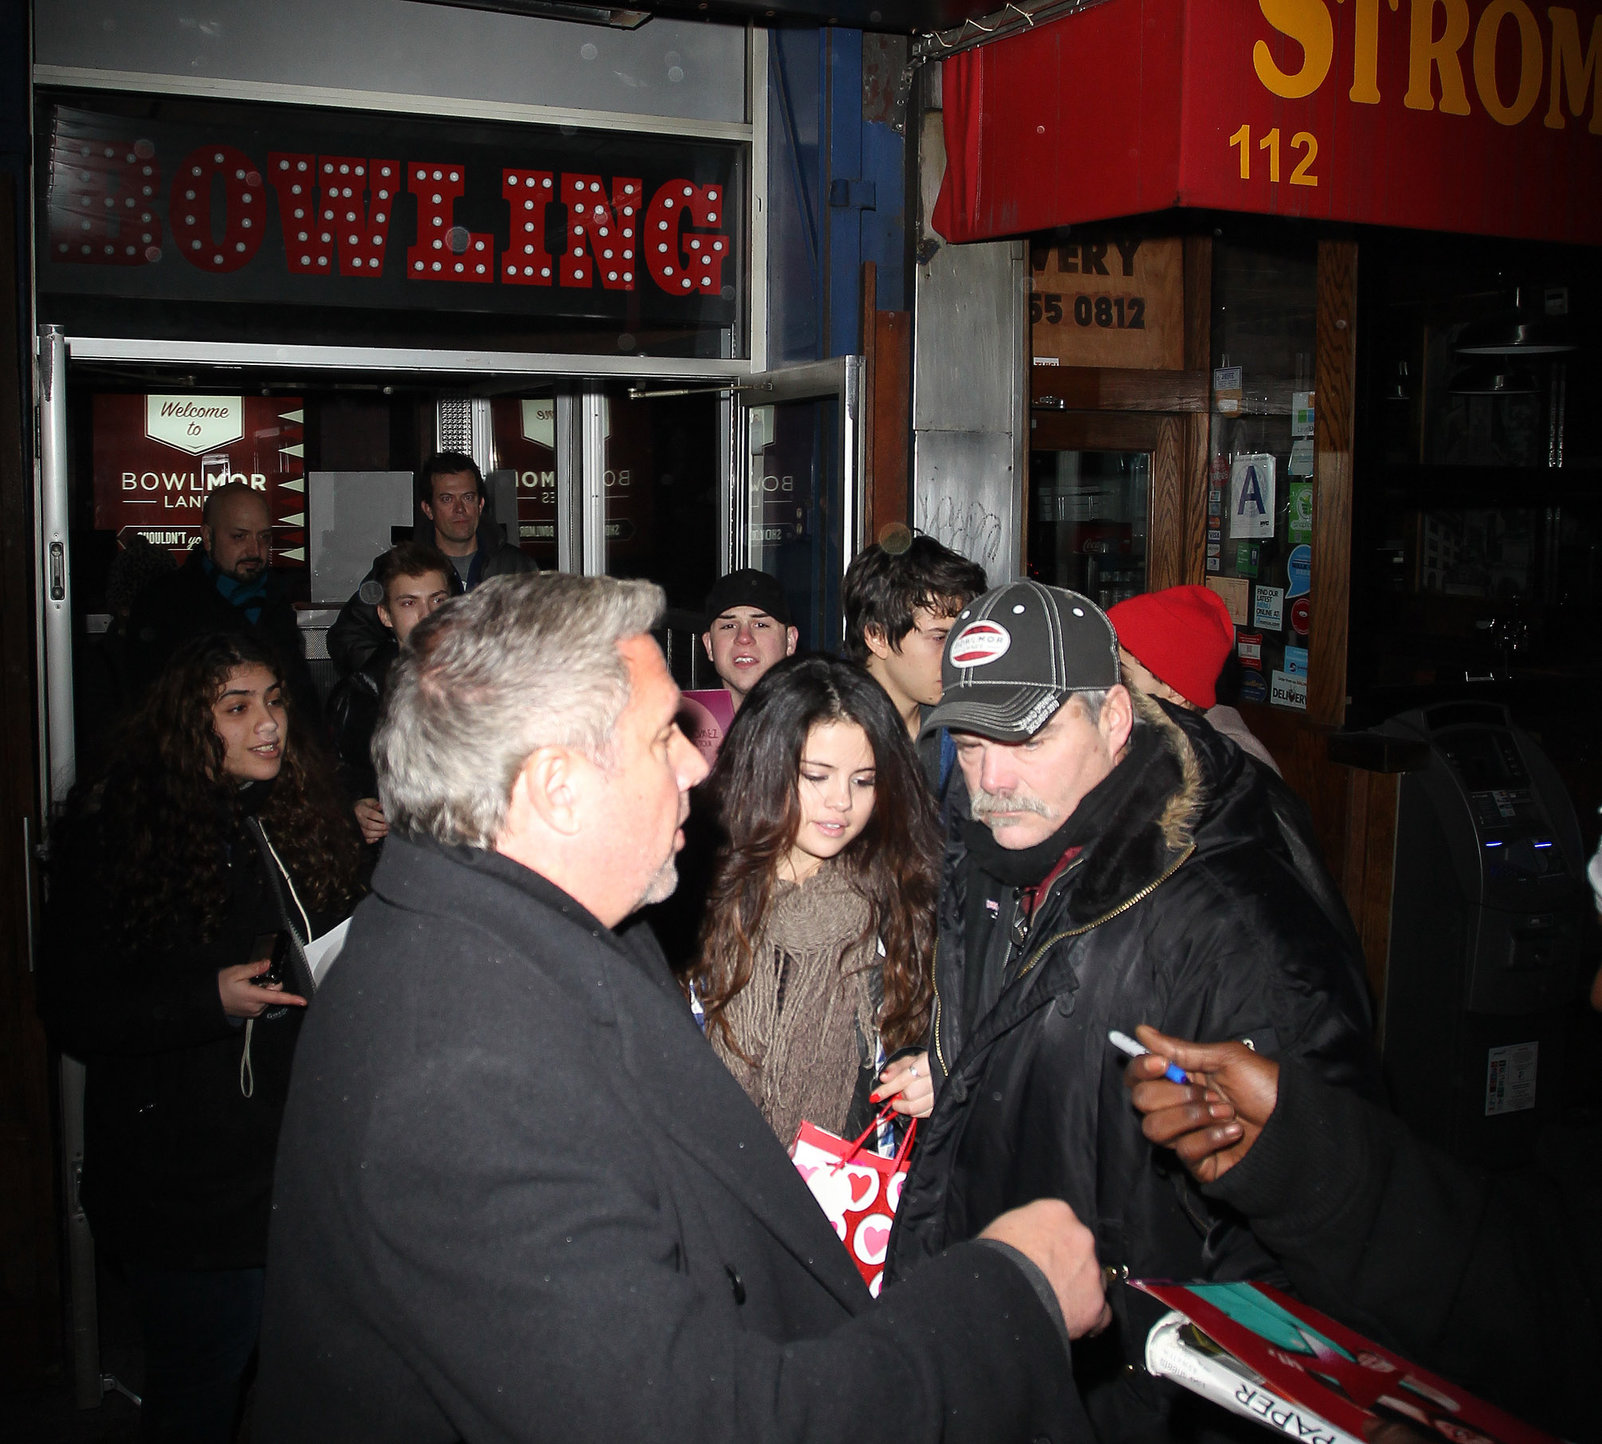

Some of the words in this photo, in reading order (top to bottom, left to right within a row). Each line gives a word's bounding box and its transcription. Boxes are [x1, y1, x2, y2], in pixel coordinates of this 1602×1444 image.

[1229, 124, 1318, 187] 112
[51, 142, 730, 296] BOWLING
[1074, 295, 1146, 330] 0812
[160, 401, 230, 419] Welcome
[186, 421, 202, 436] to
[1237, 465, 1266, 515] A
[1236, 1384, 1336, 1444] PAPER
